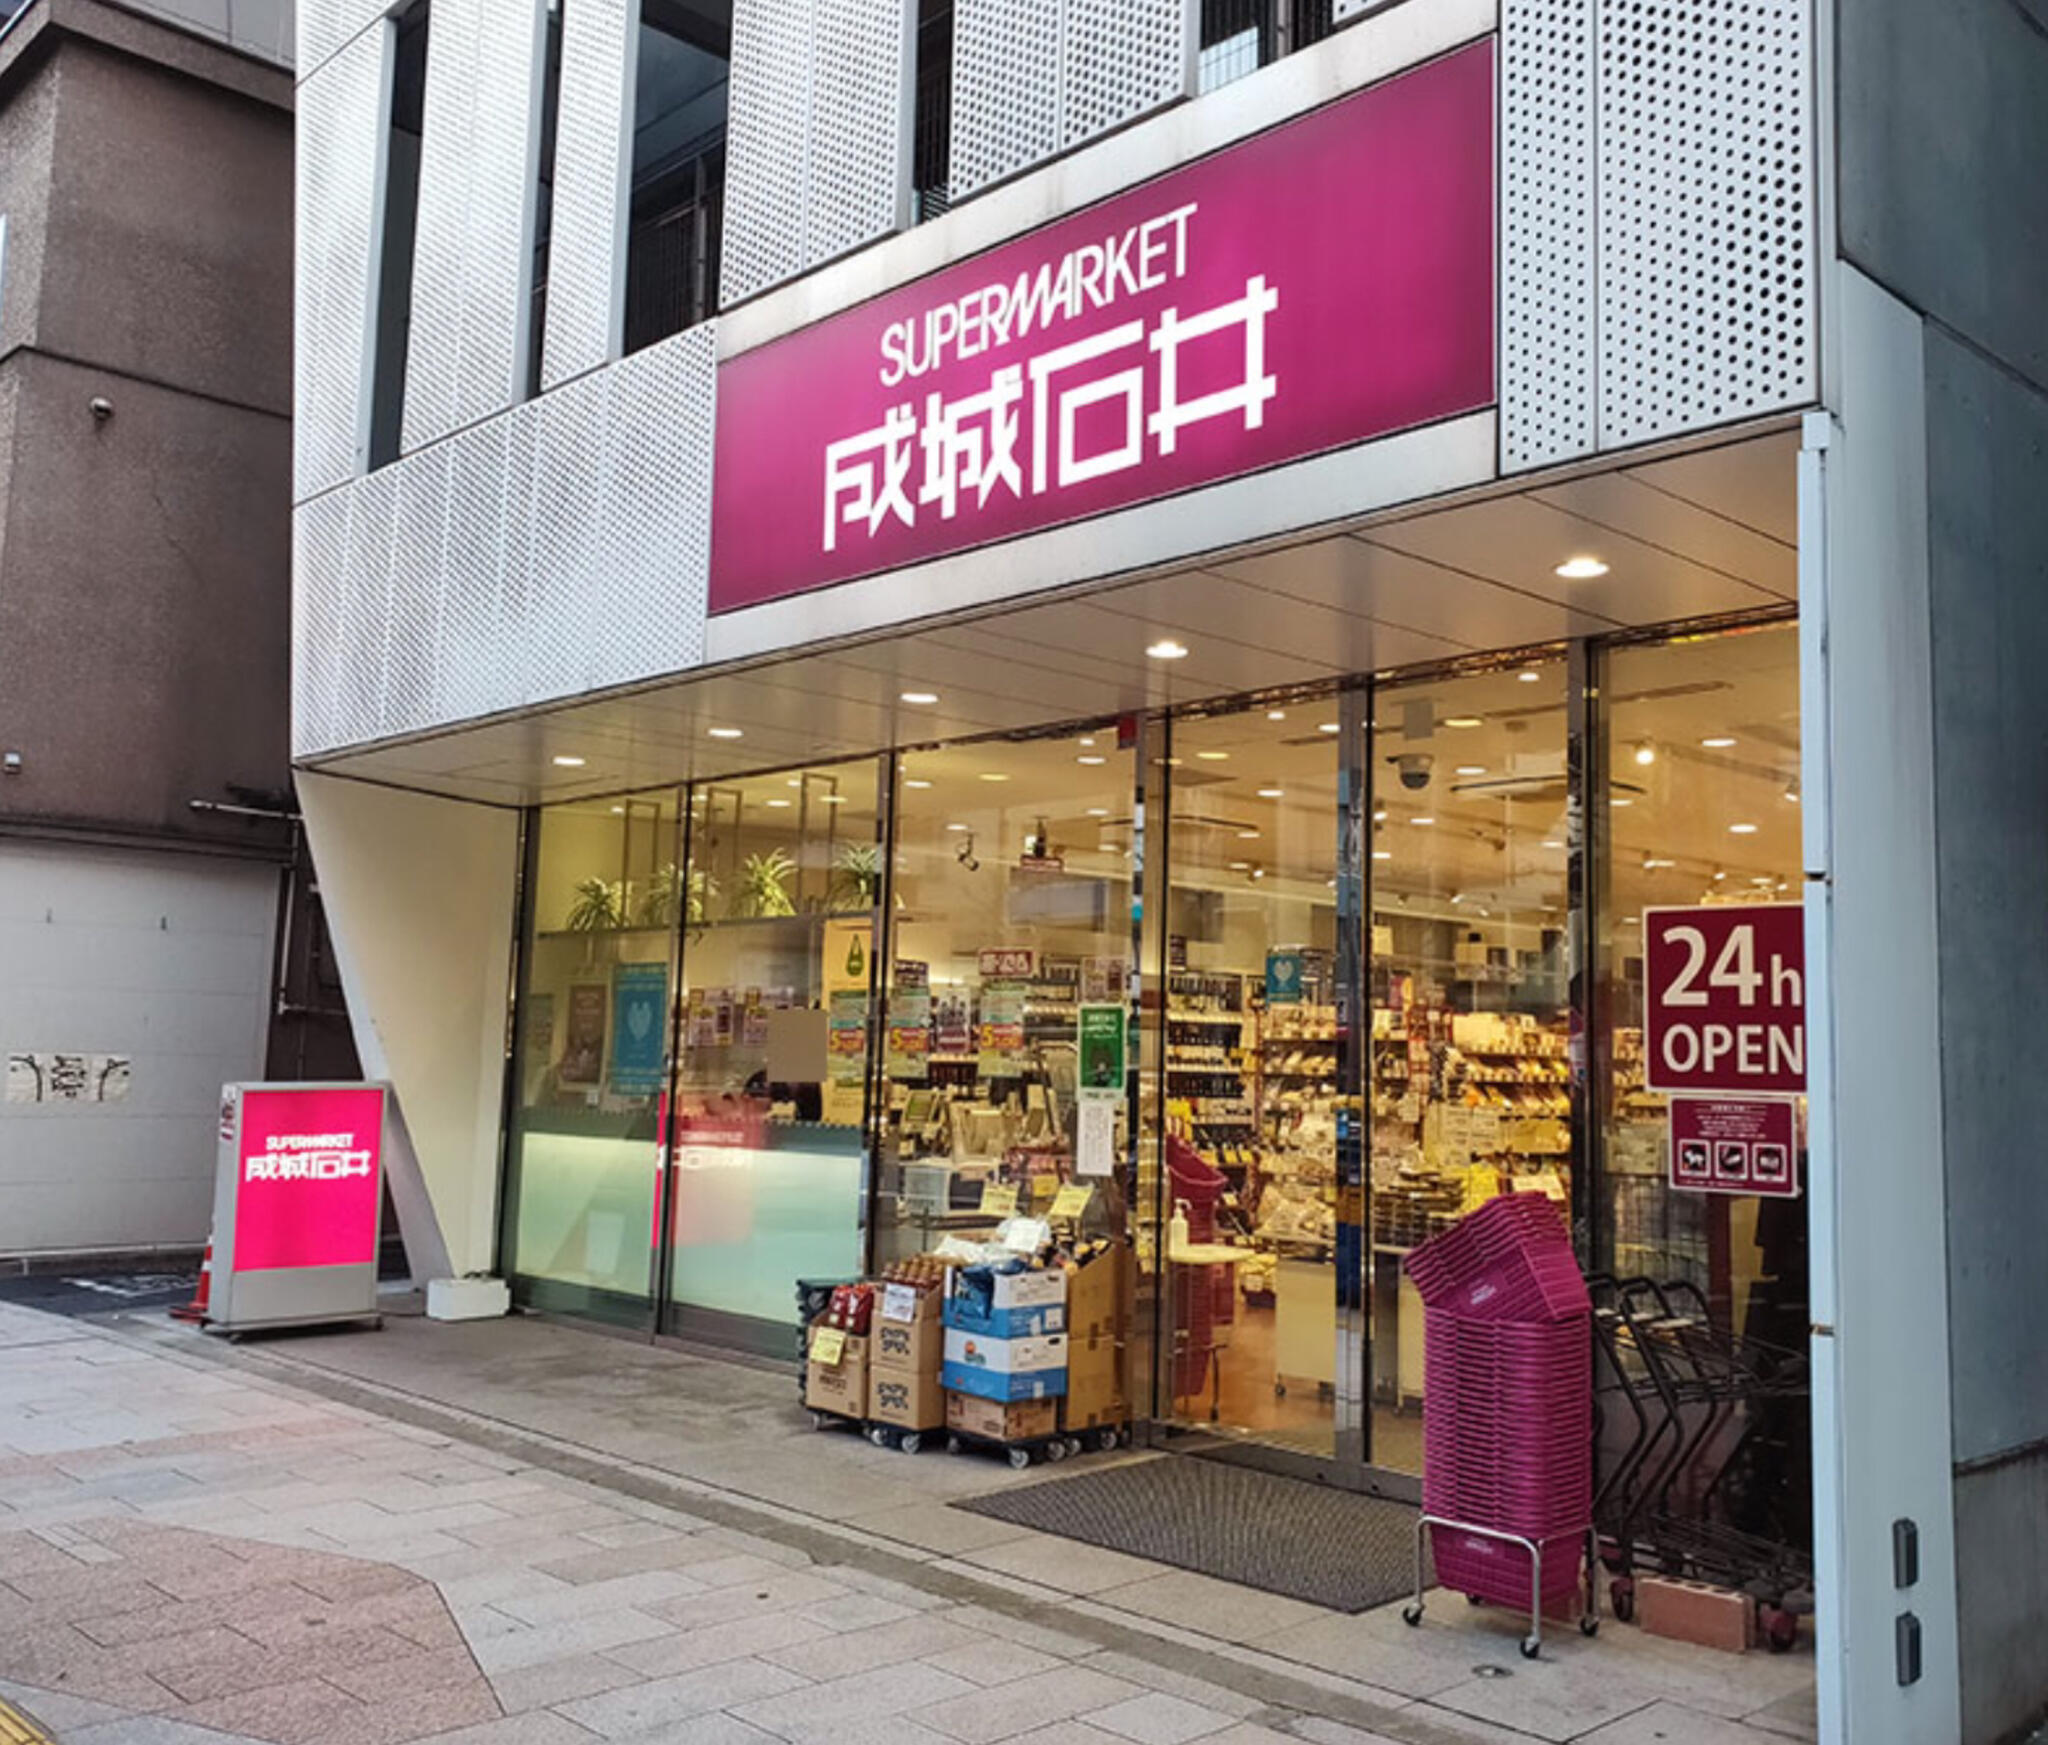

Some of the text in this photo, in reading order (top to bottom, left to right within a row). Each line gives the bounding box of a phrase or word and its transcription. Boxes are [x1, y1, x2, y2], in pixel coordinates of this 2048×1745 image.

[879, 202, 1198, 387] SUPERMARKET
[823, 274, 1279, 553] 成城石井
[1662, 1024, 1804, 1074] OPEN
[246, 1151, 371, 1181] 成城石井
